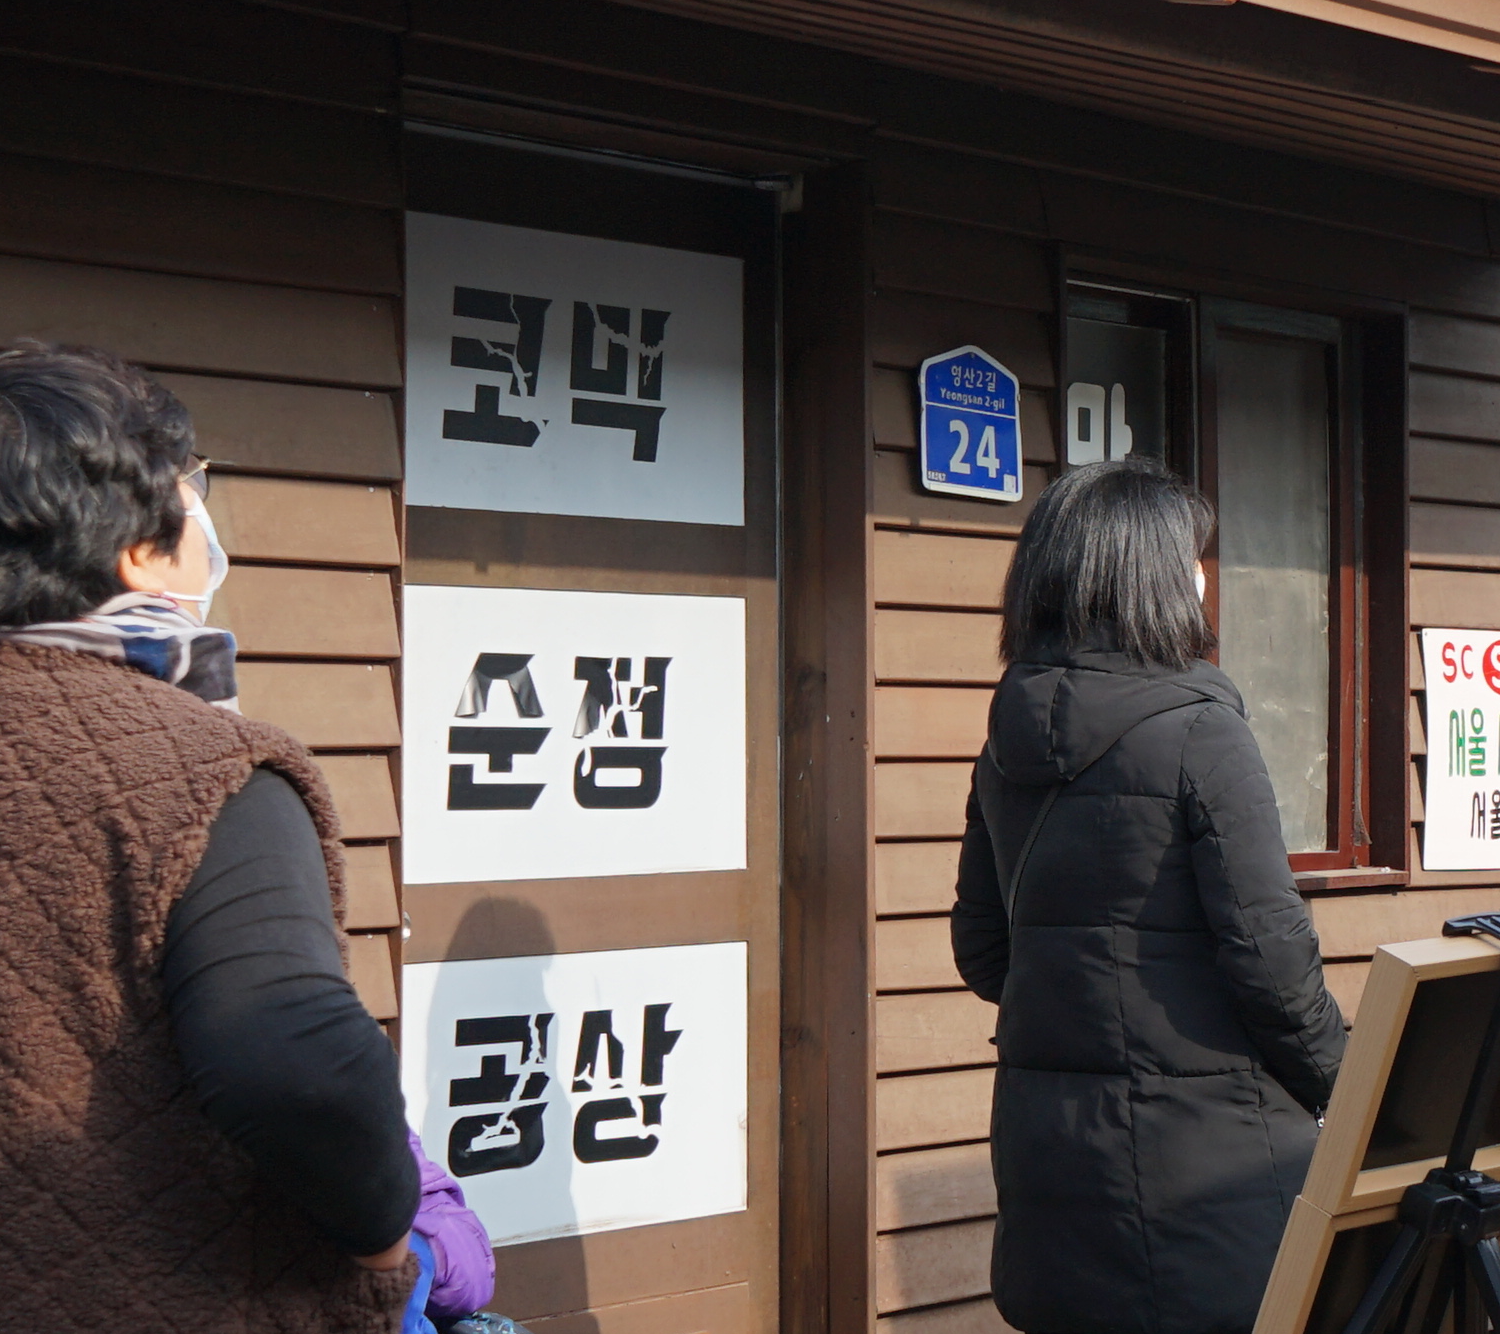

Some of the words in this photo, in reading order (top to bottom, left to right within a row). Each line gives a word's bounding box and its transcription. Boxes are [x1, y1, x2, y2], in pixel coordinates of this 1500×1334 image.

[441, 285, 671, 464] 코믹
[940, 387, 983, 406] Yeongsan
[984, 395, 1005, 411] 2-gil
[950, 364, 997, 394] 영산2길
[948, 419, 1001, 479] 24
[1441, 642, 1474, 683] SC
[447, 650, 673, 813] 순정
[1448, 707, 1488, 778] 서울
[448, 1002, 683, 1179] 공상
